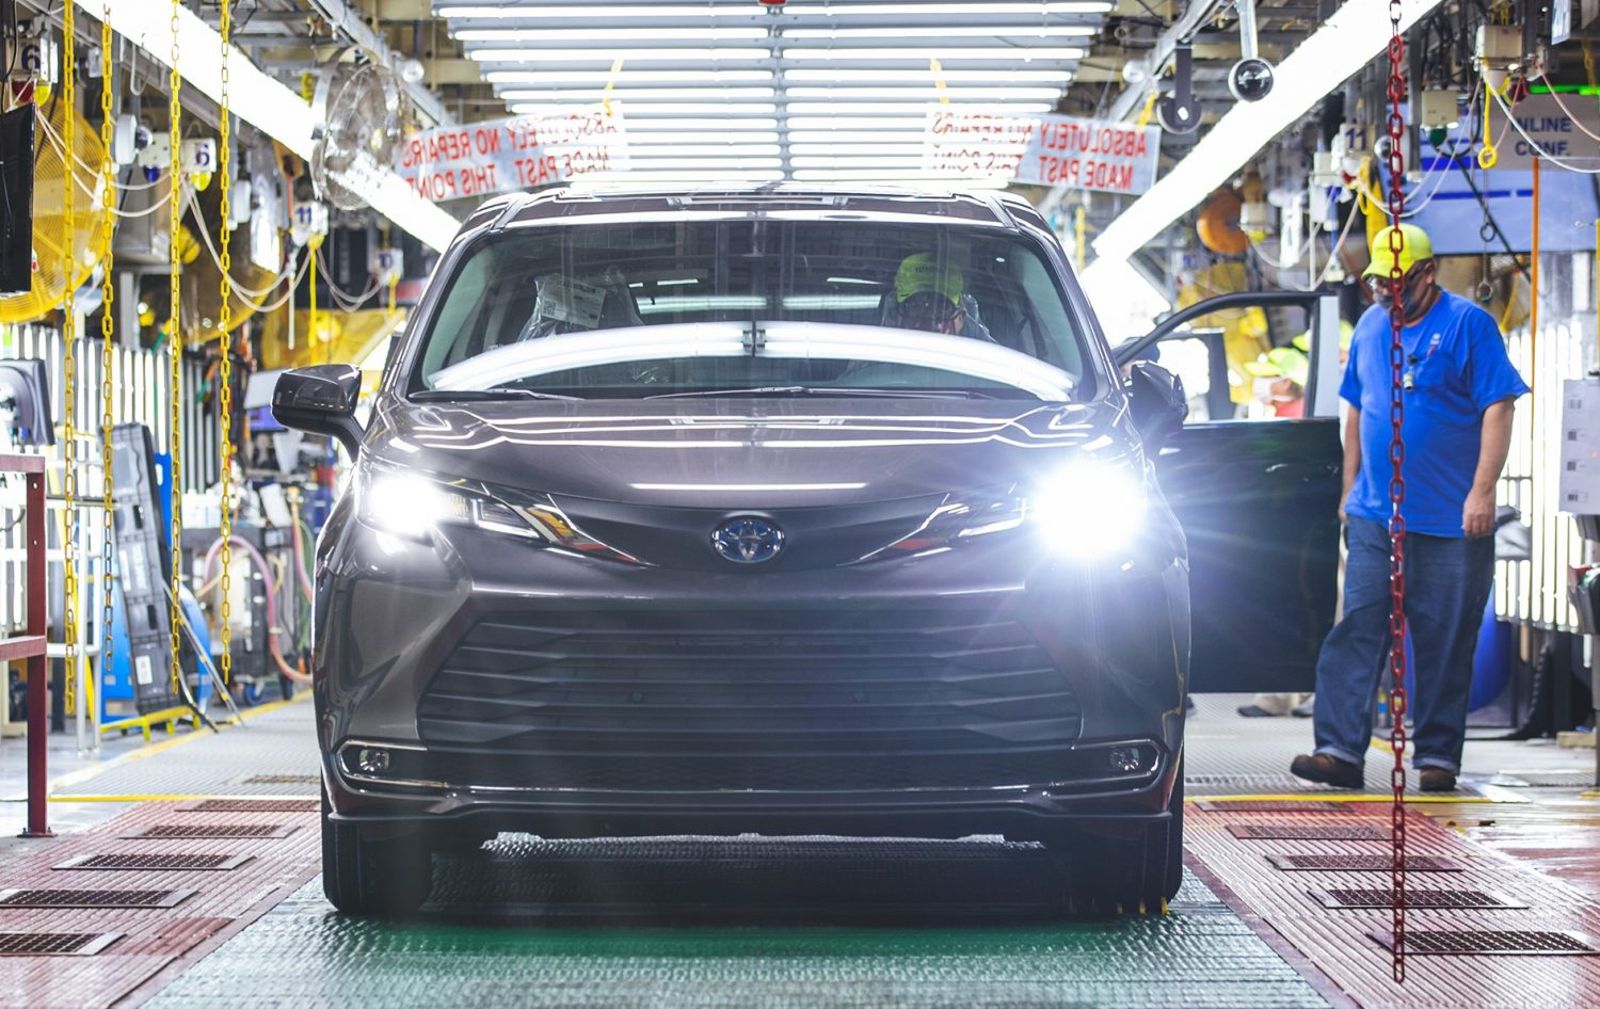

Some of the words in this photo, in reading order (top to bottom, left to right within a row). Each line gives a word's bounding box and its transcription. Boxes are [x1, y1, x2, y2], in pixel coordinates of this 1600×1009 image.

[1511, 117, 1572, 133] INLINE
[1345, 128, 1367, 151] 11
[296, 206, 312, 225] 11
